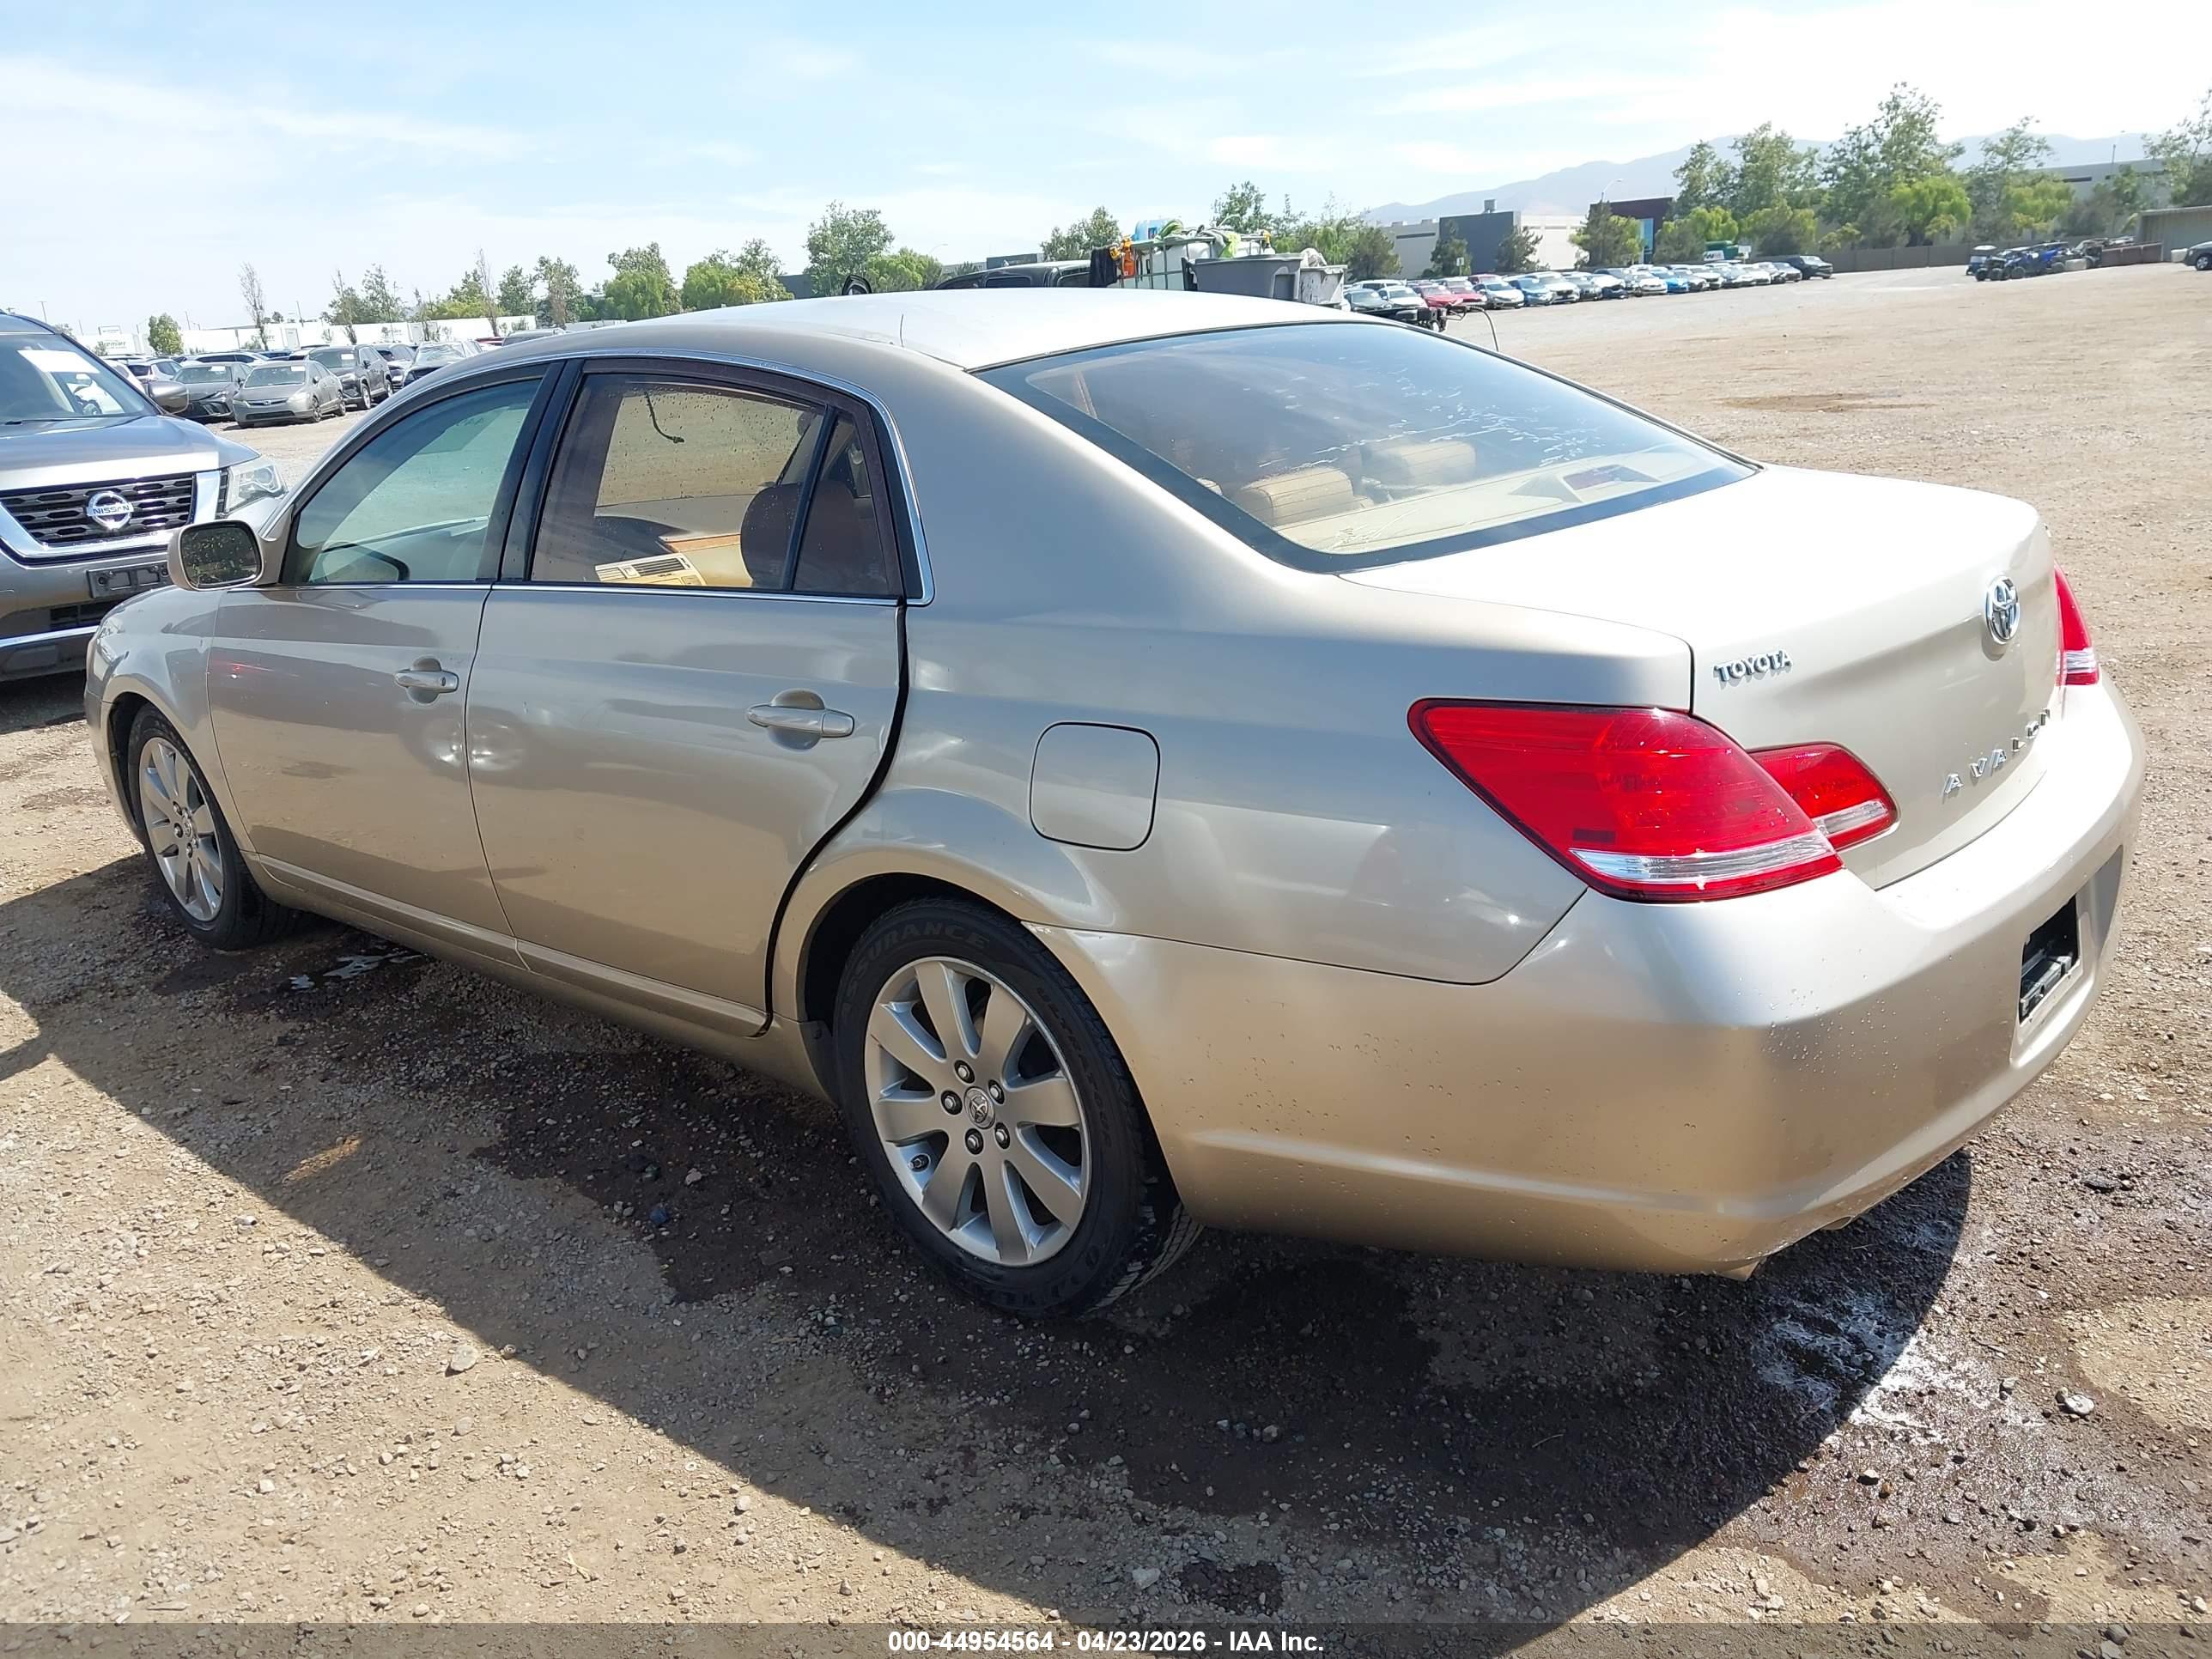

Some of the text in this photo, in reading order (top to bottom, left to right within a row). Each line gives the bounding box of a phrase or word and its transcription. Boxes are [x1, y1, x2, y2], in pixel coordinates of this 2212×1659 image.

[93, 505, 130, 514] NISSAN
[1712, 650, 1793, 683] TOYOTA
[1943, 708, 2051, 794] AVALON
[840, 921, 991, 1024] ASSURANCE
